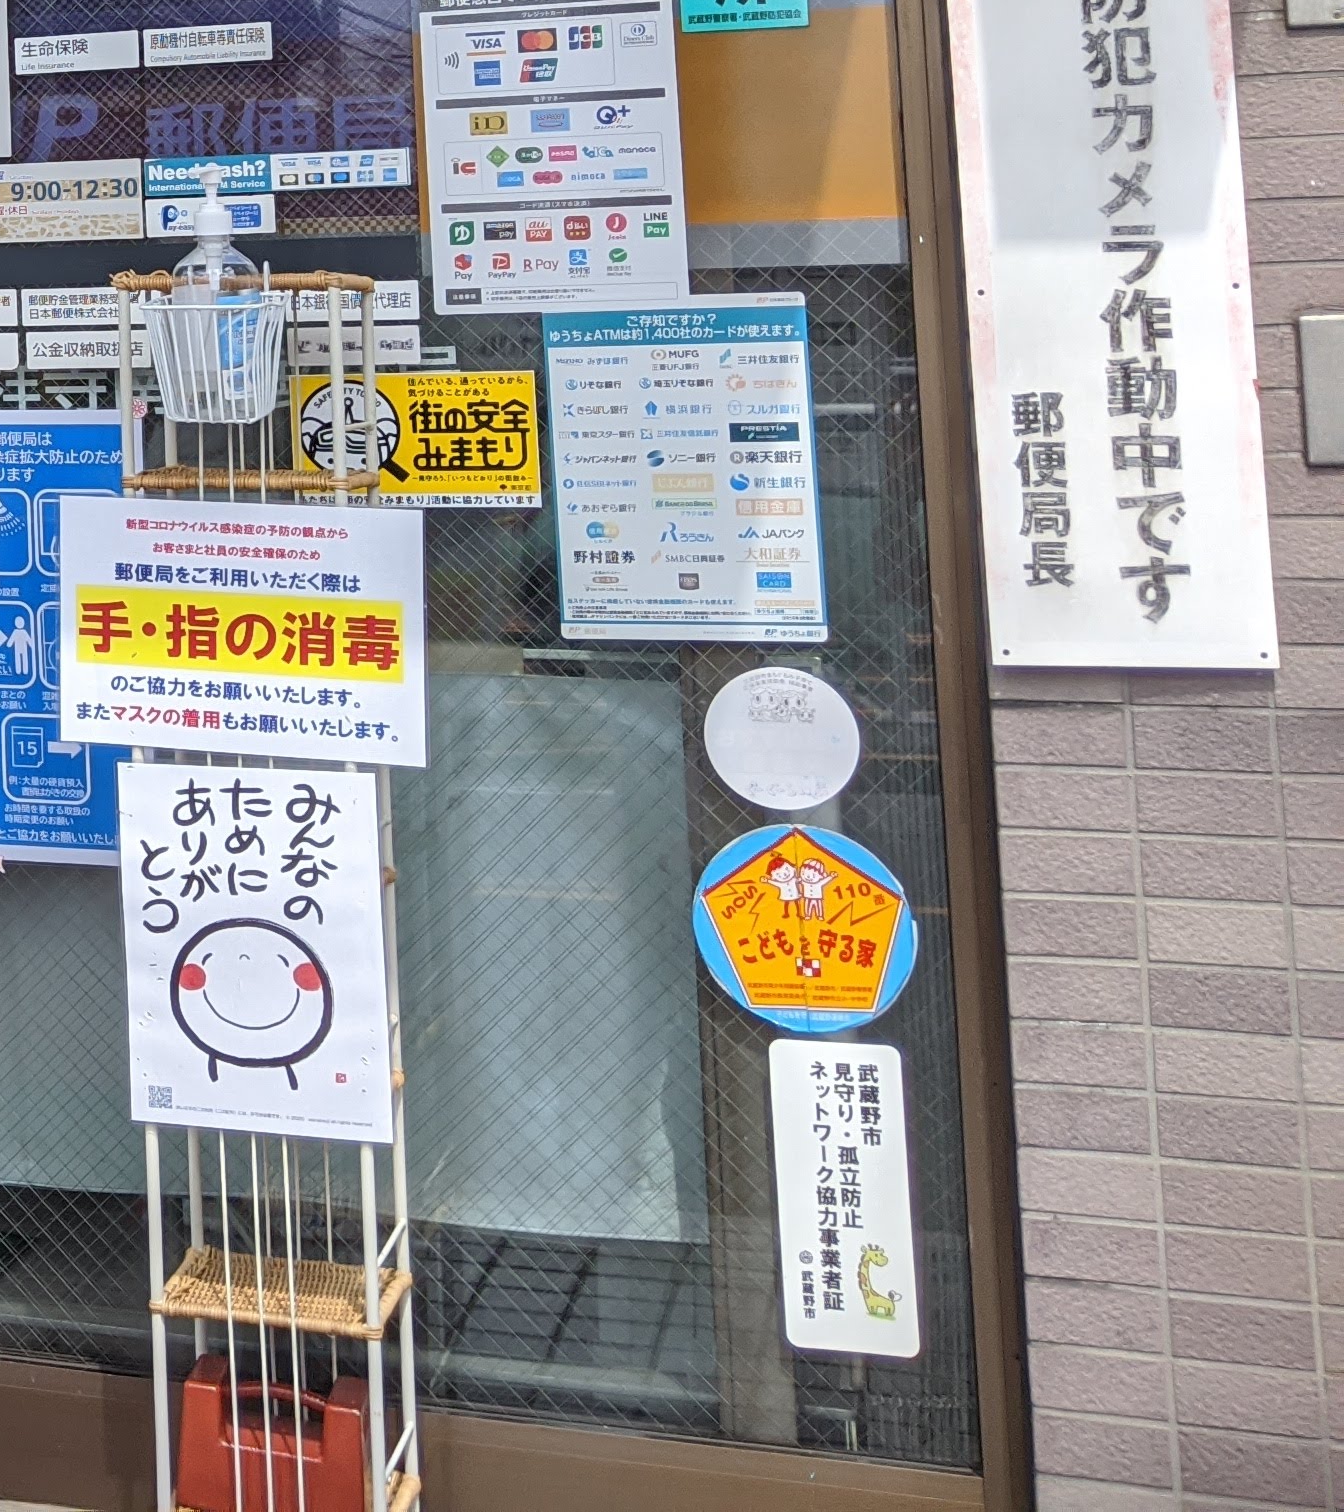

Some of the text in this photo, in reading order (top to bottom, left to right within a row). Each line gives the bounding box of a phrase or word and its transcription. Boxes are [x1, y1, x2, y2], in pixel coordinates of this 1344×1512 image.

[21, 38, 89, 58] 生命保険
[471, 38, 502, 49] VISA
[568, 25, 603, 50] JCB
[37, 60, 75, 71] Insurance
[473, 115, 506, 131] iD
[11, 178, 138, 202] 9:00-12:30
[149, 180, 266, 192] International Service
[643, 213, 668, 222] LINE
[646, 226, 667, 235] Pay
[488, 271, 516, 280] PayPay
[535, 259, 559, 271] Pay
[626, 314, 717, 328] ご存知ですか?
[668, 349, 700, 358] MUFG
[737, 354, 800, 365] 三井住友銀行
[409, 398, 531, 433] 街の安全
[665, 404, 713, 415] 横浜銀行
[413, 435, 528, 472] みまもり
[668, 453, 717, 464] ソニー銀行
[744, 451, 803, 465] 楽天銀行
[753, 476, 806, 489] 新生銀行
[1011, 390, 1076, 589] 郵便局長
[125, 517, 349, 541] 新型コロナウイルス感染症の予防の観点から
[762, 528, 805, 539] JAバンク
[152, 541, 321, 562] お客さまと社員の安全確保のため
[573, 550, 636, 565] 野村證券
[114, 561, 362, 594] 郵便局をご利用いただく際は
[78, 599, 401, 672] 手・指の消毒
[110, 675, 363, 711] のご協力をお願いいたします。
[75, 701, 402, 744] またマスクの着用もお願いいたします。
[17, 740, 39, 756] 15
[172, 777, 223, 902] ありが
[218, 777, 273, 896] ために
[280, 782, 341, 925] みんなの
[140, 838, 180, 934] とう
[721, 884, 759, 920] SOS
[737, 928, 878, 969] こどもを守る家
[857, 1063, 883, 1148] 武蔵野市
[832, 1062, 864, 1232] 見守り・孤立防止
[809, 1060, 846, 1314] ネットワーク協力事業者証
